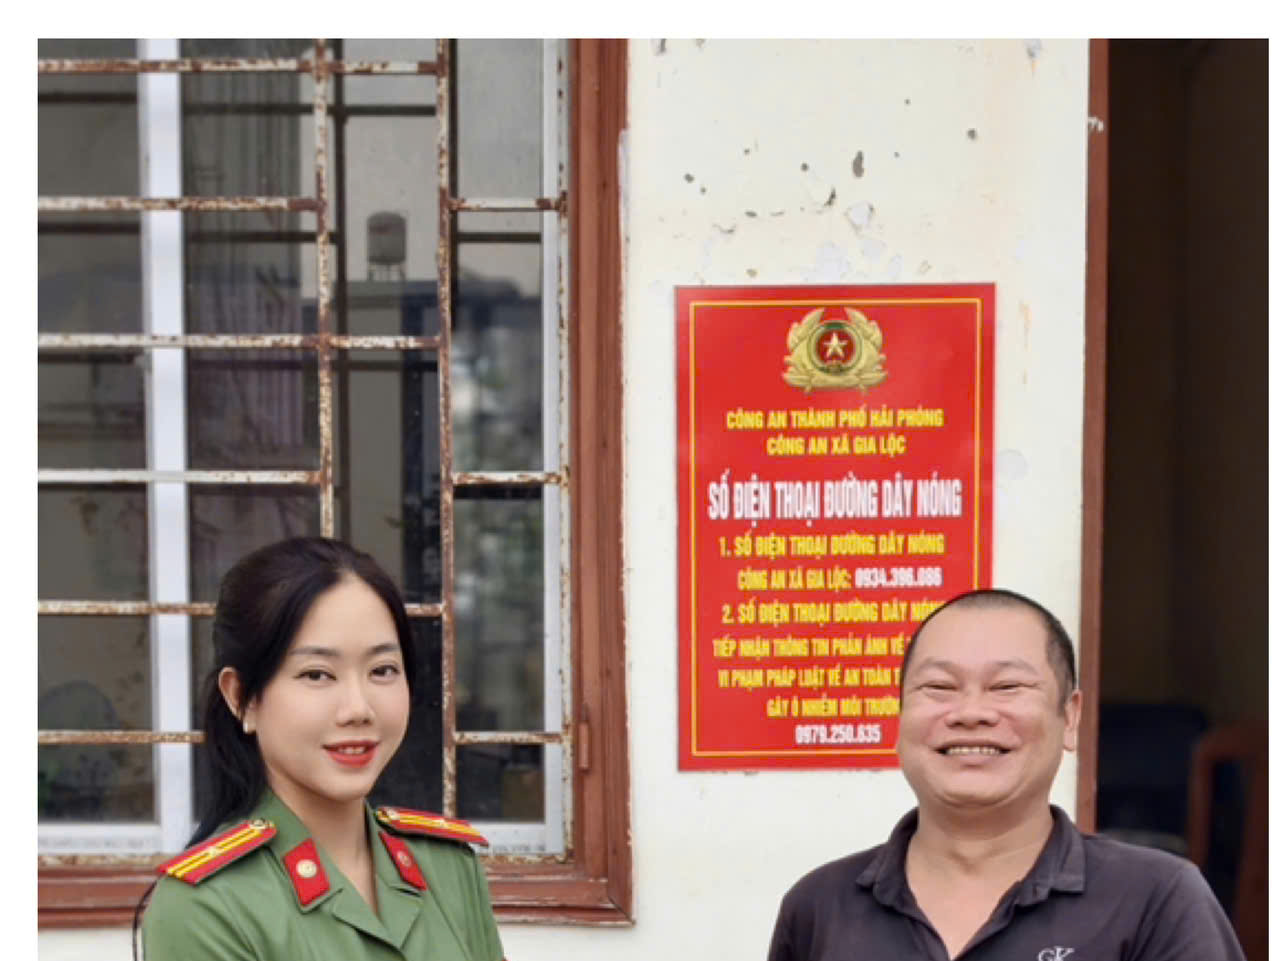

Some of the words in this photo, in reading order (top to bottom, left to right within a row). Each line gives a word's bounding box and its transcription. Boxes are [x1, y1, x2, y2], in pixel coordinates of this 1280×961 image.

[727, 406, 763, 430] CÔNG
[767, 411, 787, 429] AN
[791, 407, 836, 428] THÀNH
[840, 405, 866, 428] PHỐ
[871, 404, 894, 427] HẢI
[897, 405, 944, 427] PHÒNG
[767, 434, 805, 456] CÔNG
[809, 438, 828, 455] AN
[832, 434, 850, 455] XÃ
[853, 437, 876, 454] GIA
[880, 433, 907, 457] LỘC
[708, 468, 731, 520] SỐ
[733, 473, 771, 528] ĐIỆN
[774, 481, 820, 527] THOẠI
[824, 471, 878, 520] ĐƯỜNG
[882, 471, 913, 519] DÂY
[917, 471, 962, 517] NÓNG
[720, 536, 732, 556] 1.
[734, 529, 752, 555] SỐ
[756, 532, 786, 560] ĐIỆN
[790, 535, 828, 559] THOẠI
[831, 531, 876, 555] ĐƯỜNG
[879, 530, 905, 555] DÂY
[907, 530, 945, 555] NÓNG
[722, 604, 734, 624] 2.
[738, 597, 757, 623] SỐ
[759, 600, 790, 627] ĐIỆN
[793, 603, 831, 627] THOẠI
